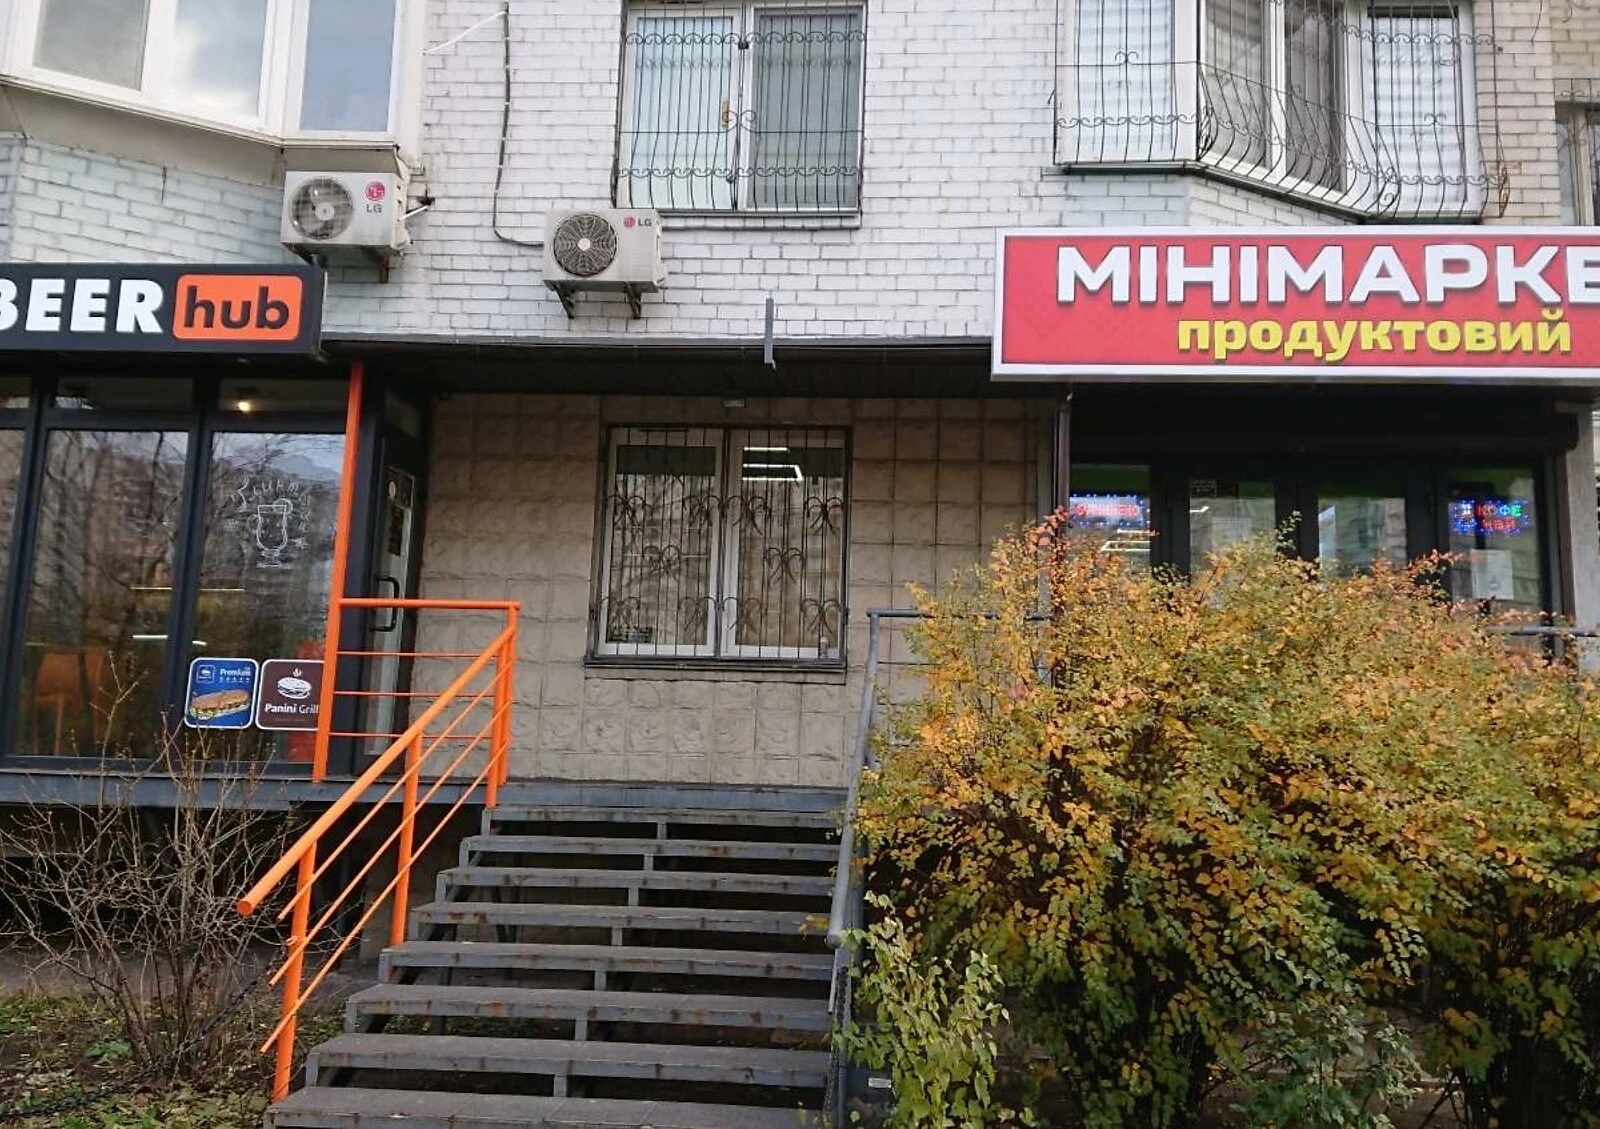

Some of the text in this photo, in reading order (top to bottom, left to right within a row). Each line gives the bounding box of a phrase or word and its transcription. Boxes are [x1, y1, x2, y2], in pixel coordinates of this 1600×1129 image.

[366, 203, 383, 214] LG
[637, 218, 652, 227] LG
[1057, 245, 1600, 304] МІНІМАРКЕ
[183, 284, 290, 330] hub
[1178, 307, 1571, 361] продуктовий
[264, 702, 319, 714] Panini Grill
